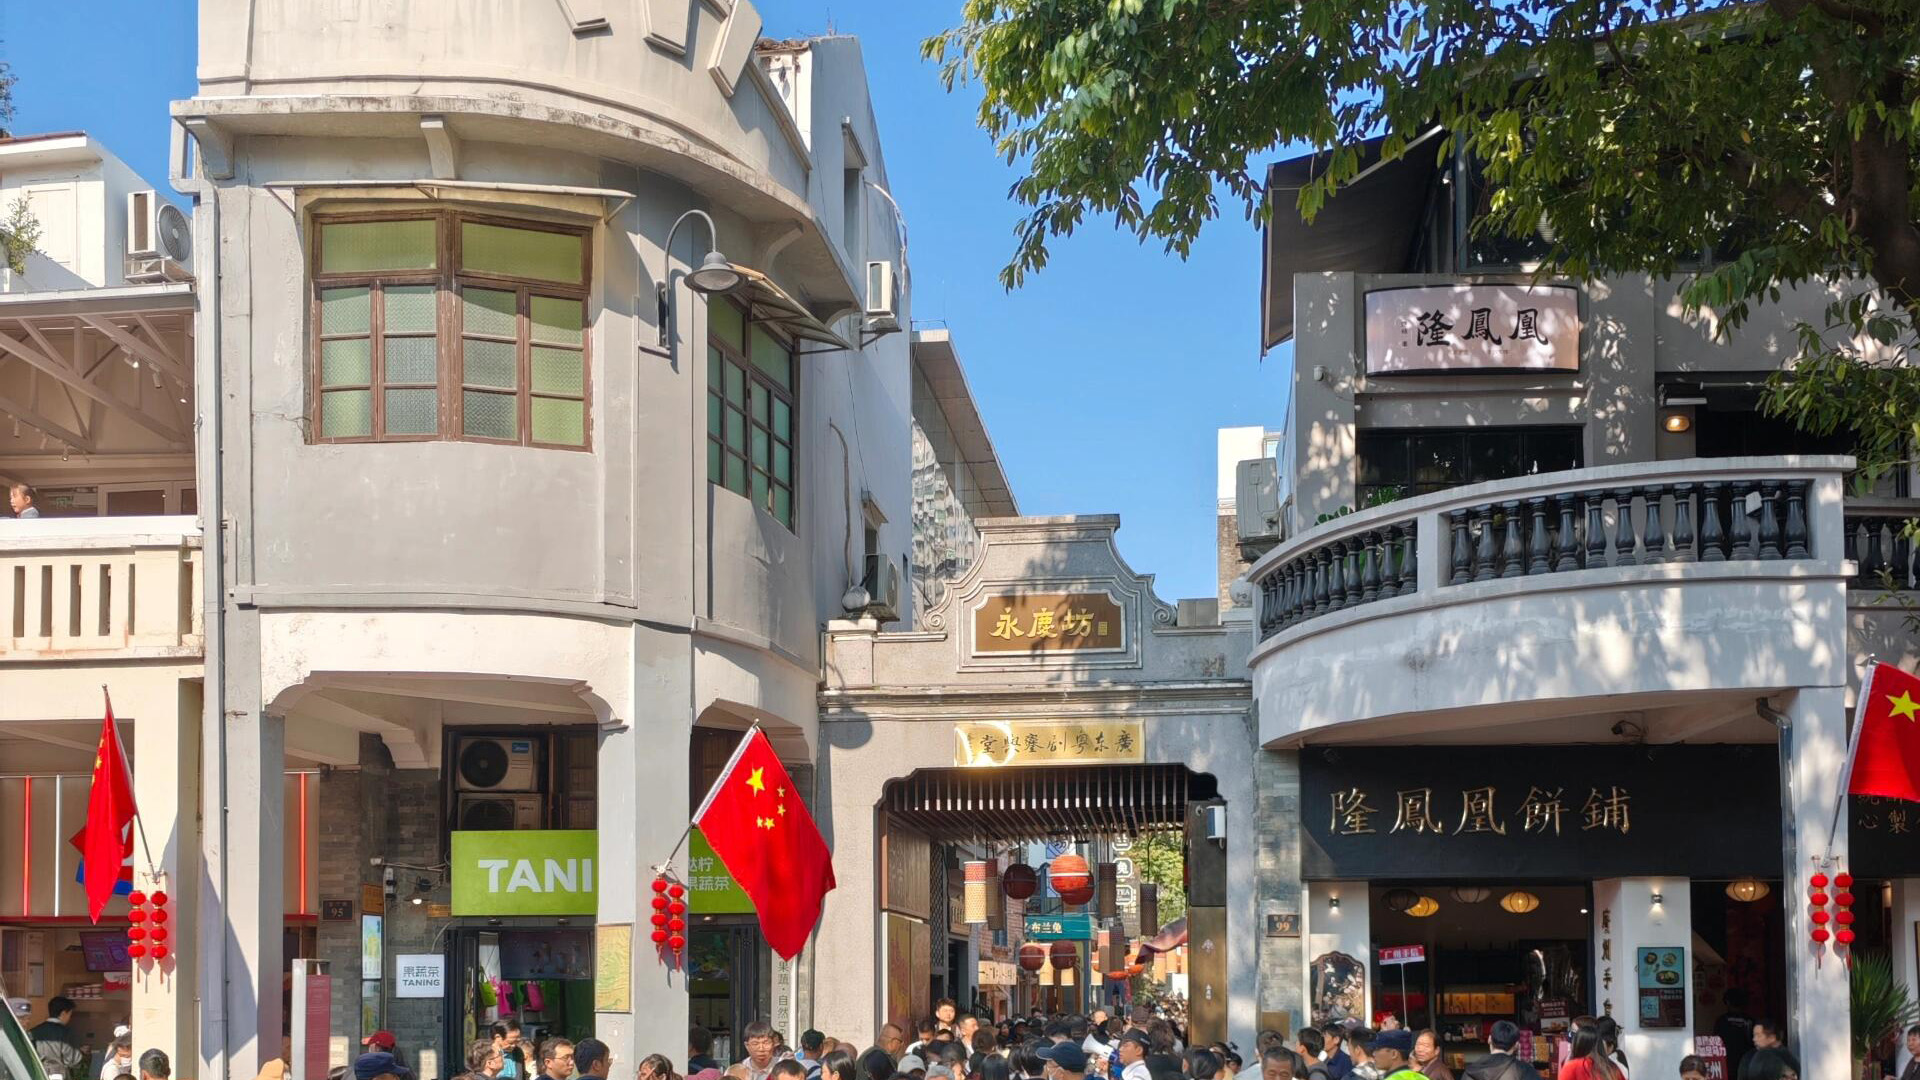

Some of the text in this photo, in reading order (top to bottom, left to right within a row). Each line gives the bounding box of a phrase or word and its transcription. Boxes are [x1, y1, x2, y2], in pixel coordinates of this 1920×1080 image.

[1417, 307, 1549, 347] 隆鳳凰
[988, 607, 1094, 640] 永慶坊
[1329, 786, 1632, 837] 隆鳳凰餅鋪
[478, 858, 593, 893] TANI
[331, 907, 344, 918] 95
[1276, 921, 1290, 932] 99
[403, 966, 440, 978] 果蔬茶
[403, 979, 441, 987] TANING
